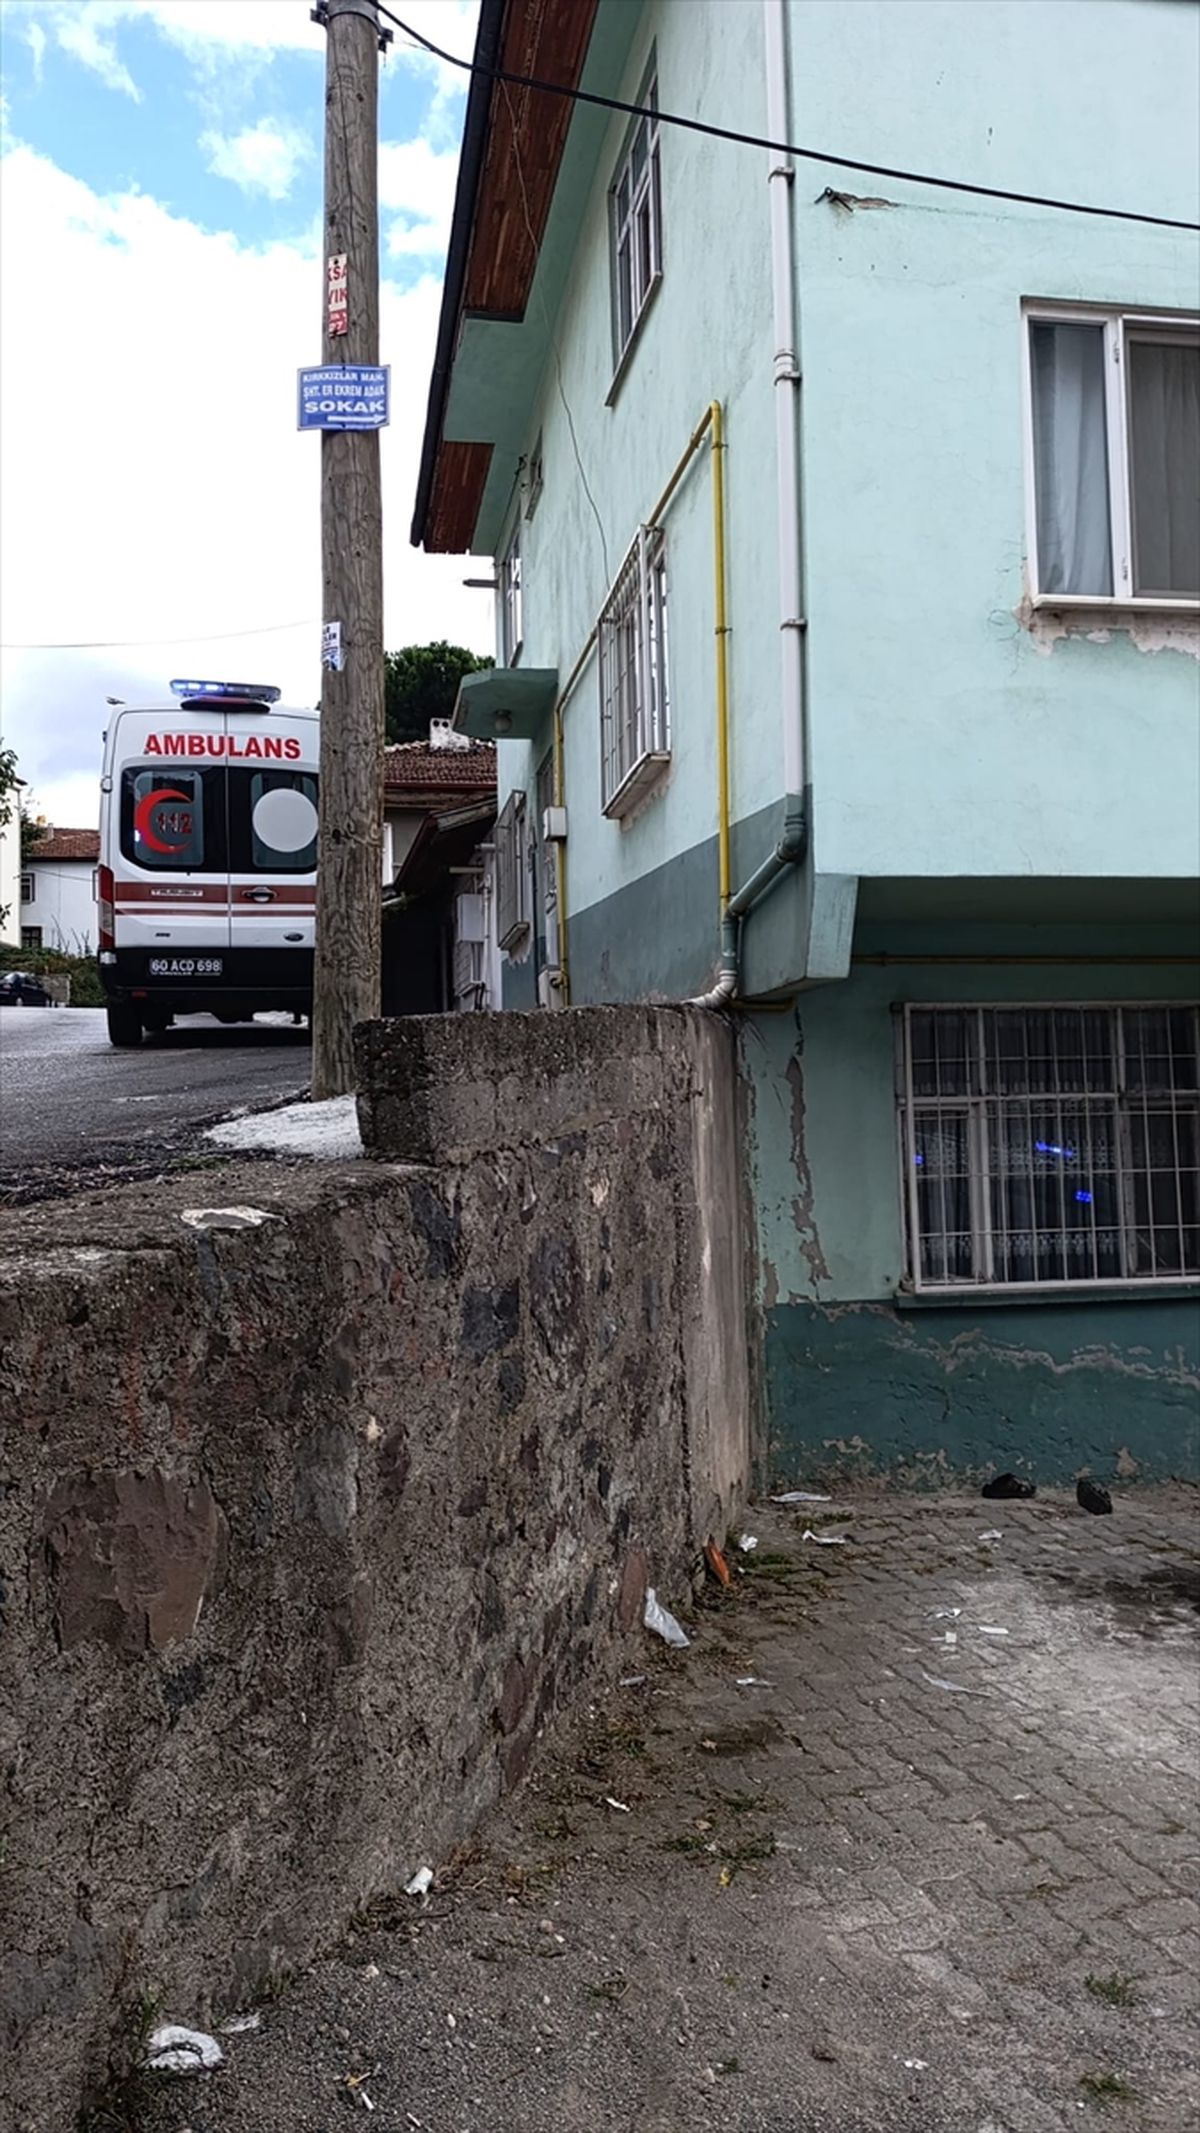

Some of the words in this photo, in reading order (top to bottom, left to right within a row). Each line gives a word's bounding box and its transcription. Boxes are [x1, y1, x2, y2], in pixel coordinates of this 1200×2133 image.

[322, 385, 333, 397] ER
[334, 385, 362, 397] EKREM
[364, 386, 385, 397] ADAK
[305, 401, 384, 413] SOKAK
[144, 735, 301, 759] AMBULANS
[156, 812, 193, 834] 112
[152, 959, 168, 972] 60
[170, 959, 195, 972] ACD
[197, 959, 221, 972] 698
